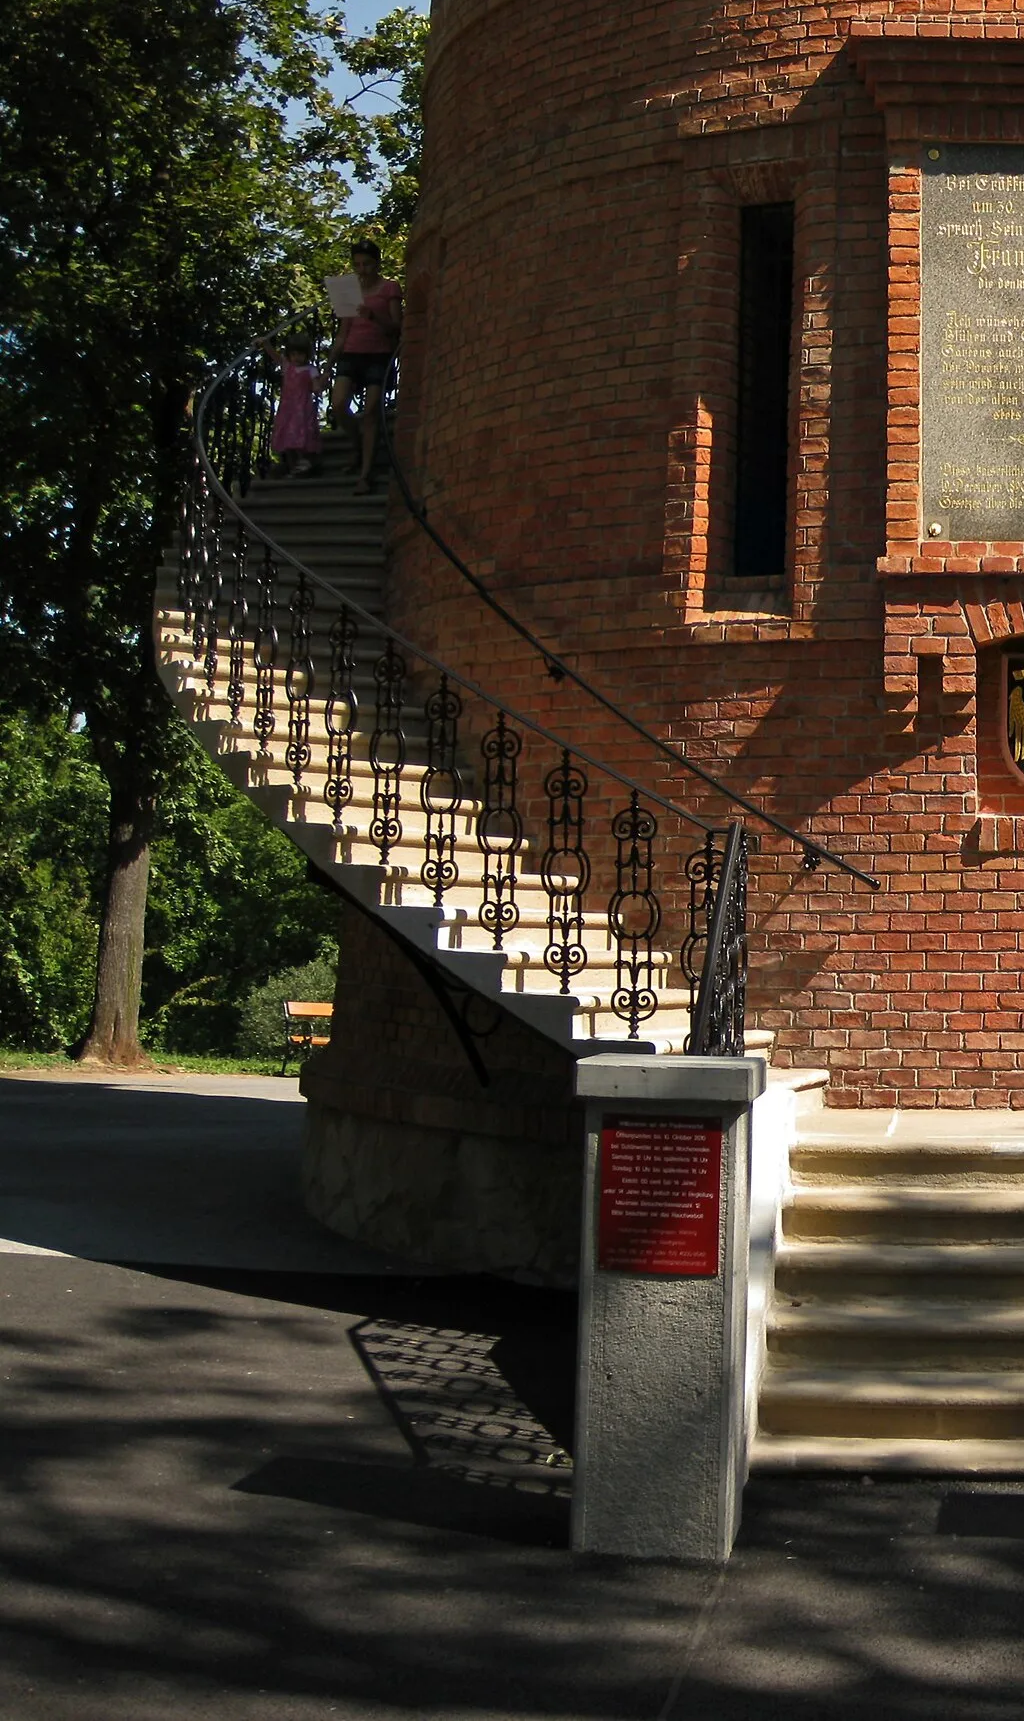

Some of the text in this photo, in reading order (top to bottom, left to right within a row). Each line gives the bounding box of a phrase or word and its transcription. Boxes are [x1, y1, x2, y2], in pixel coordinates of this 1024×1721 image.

[941, 174, 970, 192] Bei
[972, 200, 993, 214] am
[997, 200, 1015, 214] 30.
[936, 218, 983, 240] sprach
[978, 276, 994, 290] die
[945, 310, 972, 328] Ich
[942, 328, 987, 343] Blühen
[992, 330, 1014, 343] und
[941, 344, 993, 358] Gartens
[998, 346, 1024, 359] auch
[941, 361, 961, 373] der
[968, 378, 993, 390] wird
[998, 378, 1024, 392] auch
[966, 392, 986, 405] der
[991, 393, 1018, 406] alten
[992, 408, 1022, 421] stets
[1009, 497, 1023, 509] die
